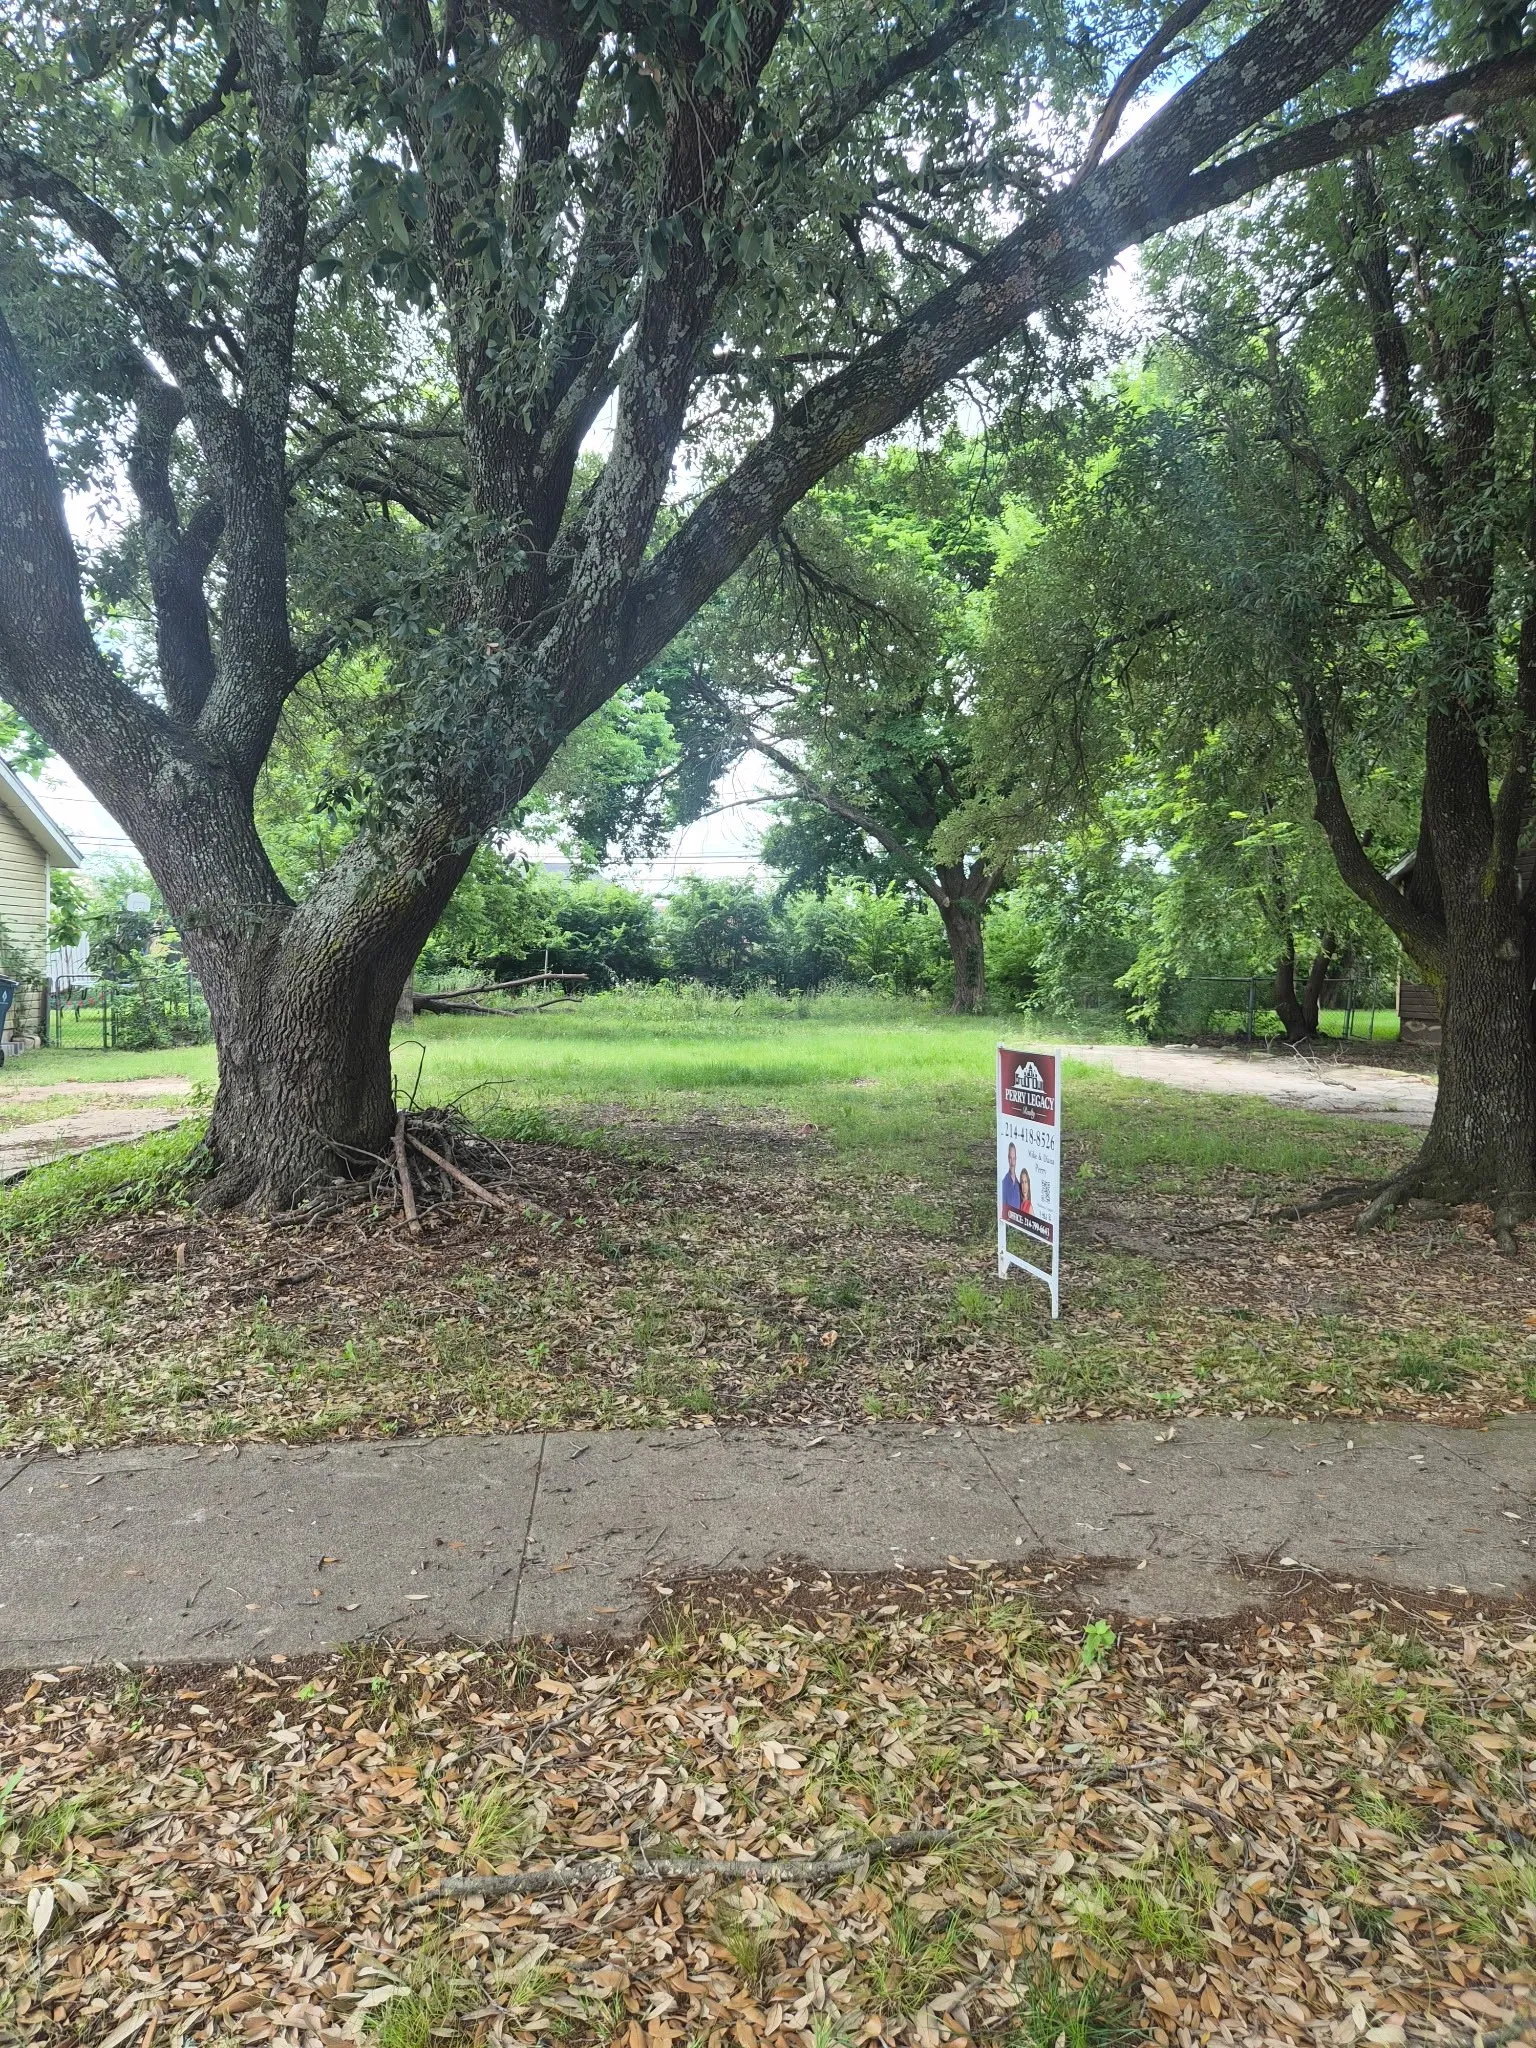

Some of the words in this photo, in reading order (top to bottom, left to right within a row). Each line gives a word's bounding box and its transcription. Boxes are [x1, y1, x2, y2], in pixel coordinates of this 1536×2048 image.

[1005, 1088, 1026, 1104] PERRY
[1028, 1094, 1055, 1111] LEGACY
[1005, 1122, 1055, 1151] 214-418-8526
